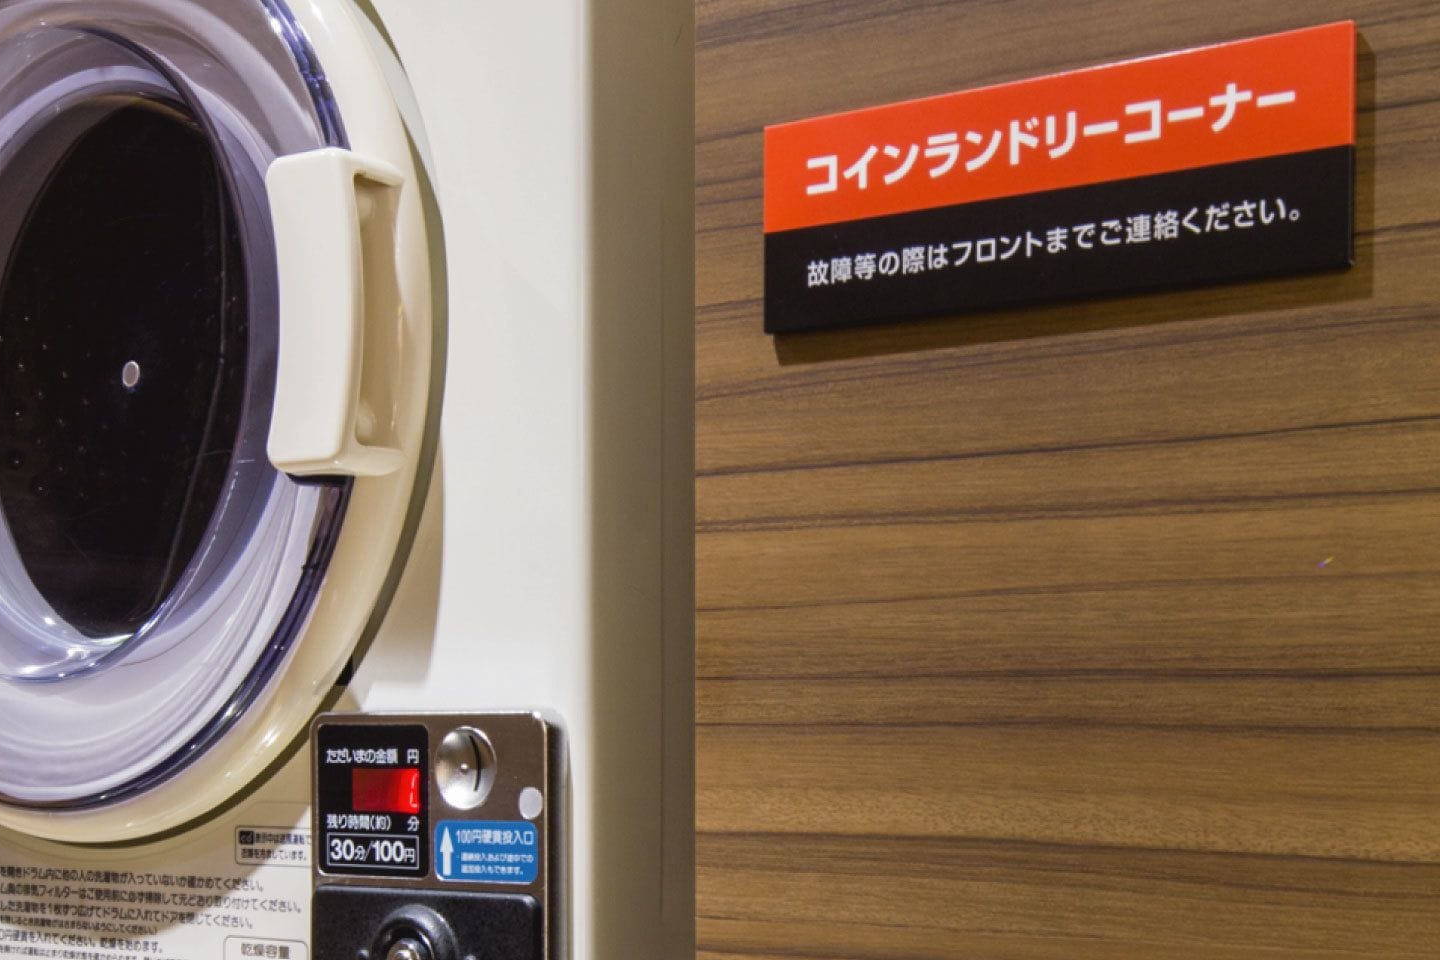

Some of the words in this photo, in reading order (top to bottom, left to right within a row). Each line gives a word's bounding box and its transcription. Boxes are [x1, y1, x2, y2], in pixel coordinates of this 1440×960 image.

[805, 82, 1296, 196] コインランドリーコーナー
[806, 197, 1301, 287] 故障等の際はフロントまでご連絡ください。
[326, 747, 398, 764] ただいまの金額
[406, 748, 420, 764] 円
[326, 813, 391, 830] 残り時間(約)
[407, 816, 420, 832] 分
[330, 838, 416, 863] 30分/100円
